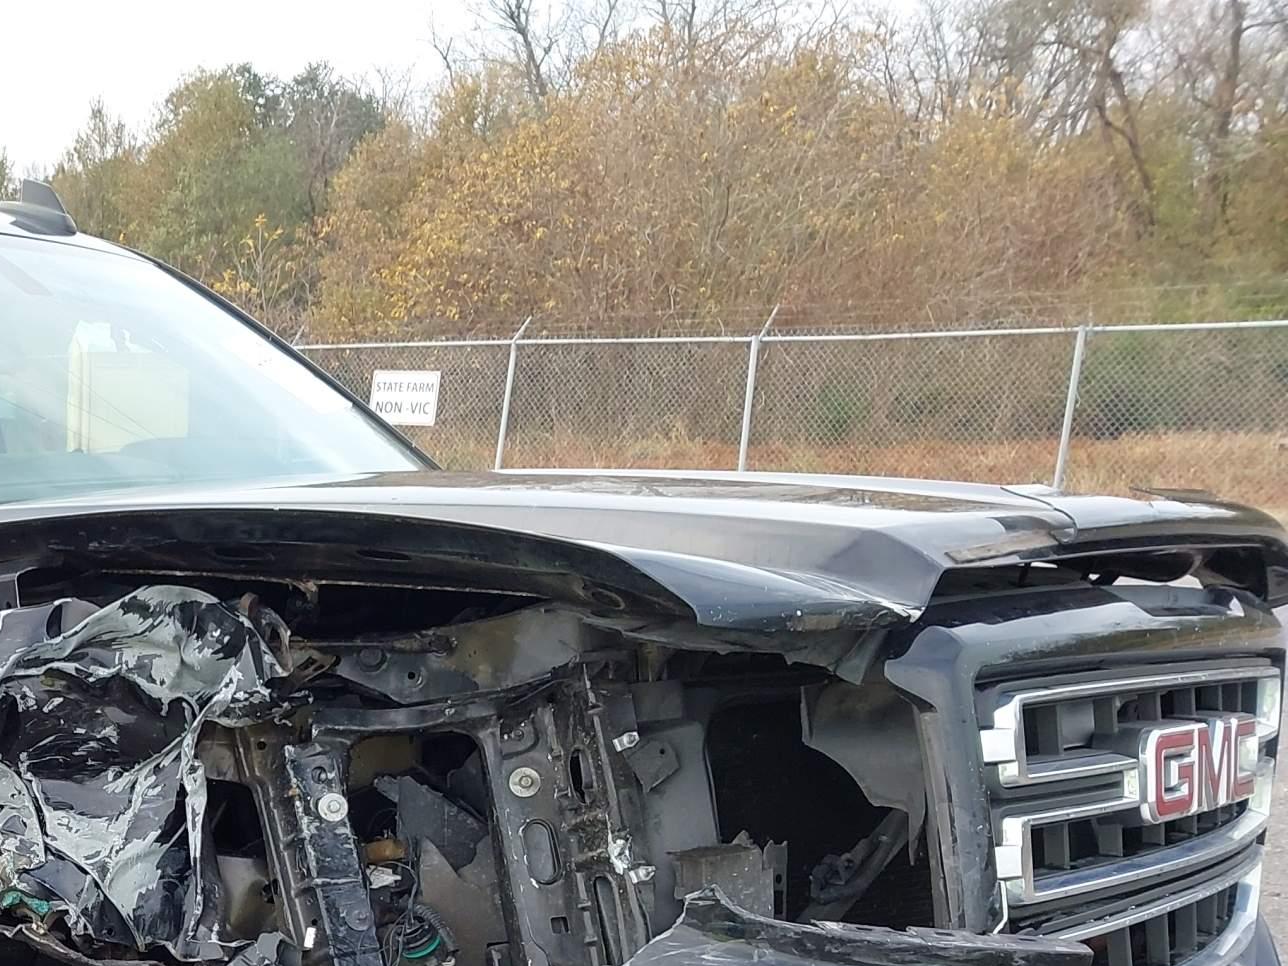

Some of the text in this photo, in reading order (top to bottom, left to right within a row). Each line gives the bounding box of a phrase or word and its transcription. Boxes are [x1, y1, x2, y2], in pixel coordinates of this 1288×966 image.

[376, 381, 434, 393] STATE FARM
[1148, 717, 1258, 822] GMC
